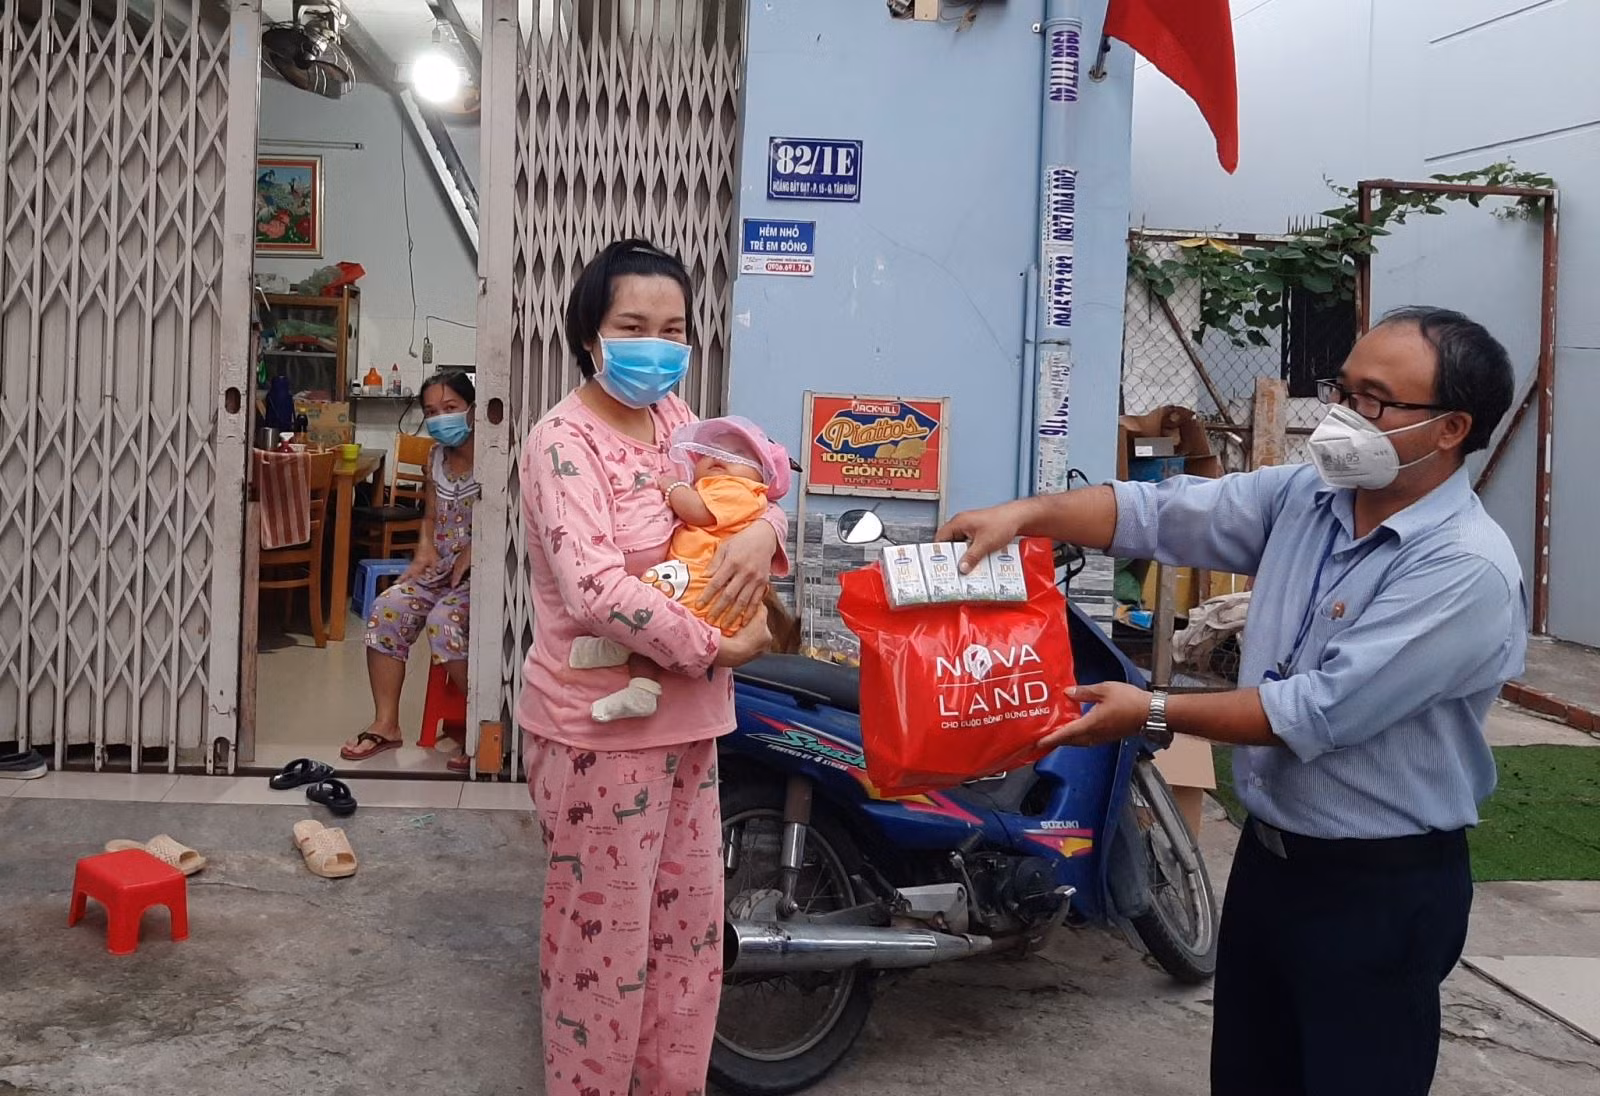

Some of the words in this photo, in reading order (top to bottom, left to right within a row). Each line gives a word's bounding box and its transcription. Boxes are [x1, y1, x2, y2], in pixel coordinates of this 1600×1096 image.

[776, 145, 855, 176] 82/1E
[780, 224, 800, 238] NHỎ
[750, 237, 765, 251] TRẺ
[766, 241, 779, 251] EM
[781, 239, 808, 252] ĐÔNG
[823, 414, 929, 450] Piattos
[820, 452, 865, 465] 100%
[841, 464, 884, 477] GIÒN
[887, 467, 921, 479] TAN
[938, 681, 1049, 717] LAND
[941, 720, 959, 729] CHO
[1040, 820, 1079, 830] SUZUKI
